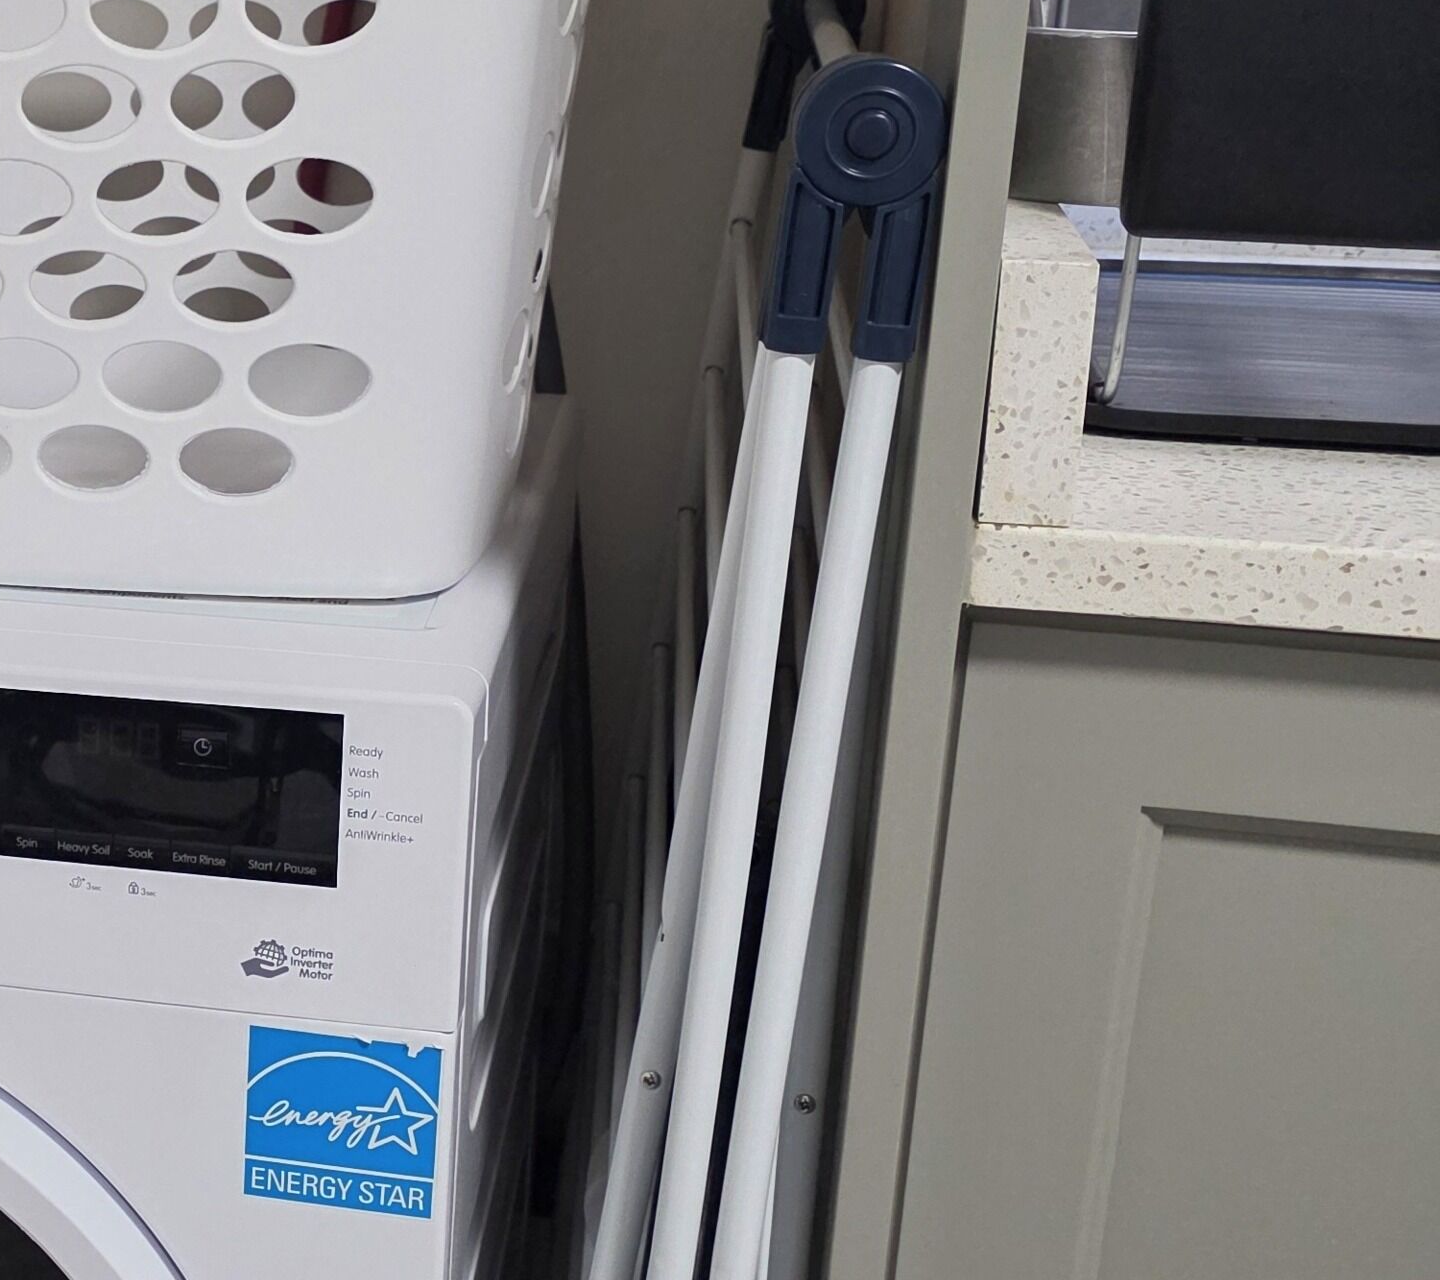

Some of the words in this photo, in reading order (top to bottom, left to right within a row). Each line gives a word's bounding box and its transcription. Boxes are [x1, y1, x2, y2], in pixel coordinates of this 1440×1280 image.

[349, 745, 383, 760] Ready
[349, 767, 379, 778] Wash
[347, 787, 371, 800] Spin
[347, 808, 368, 819] End
[16, 836, 38, 848] Spin
[345, 829, 414, 843] AntiWrinkle+
[57, 841, 90, 855] Heavy
[92, 844, 110, 856] Soil
[128, 848, 153, 859] Soak
[172, 852, 197, 864] Extra
[199, 854, 226, 867] Rinse
[248, 859, 273, 871] Start
[284, 863, 317, 876] Pause
[292, 946, 333, 959] Optima
[291, 957, 333, 970] Inverter
[299, 969, 333, 980] Motor
[251, 1167, 352, 1200] ENERGY
[359, 1181, 424, 1210] STAR
